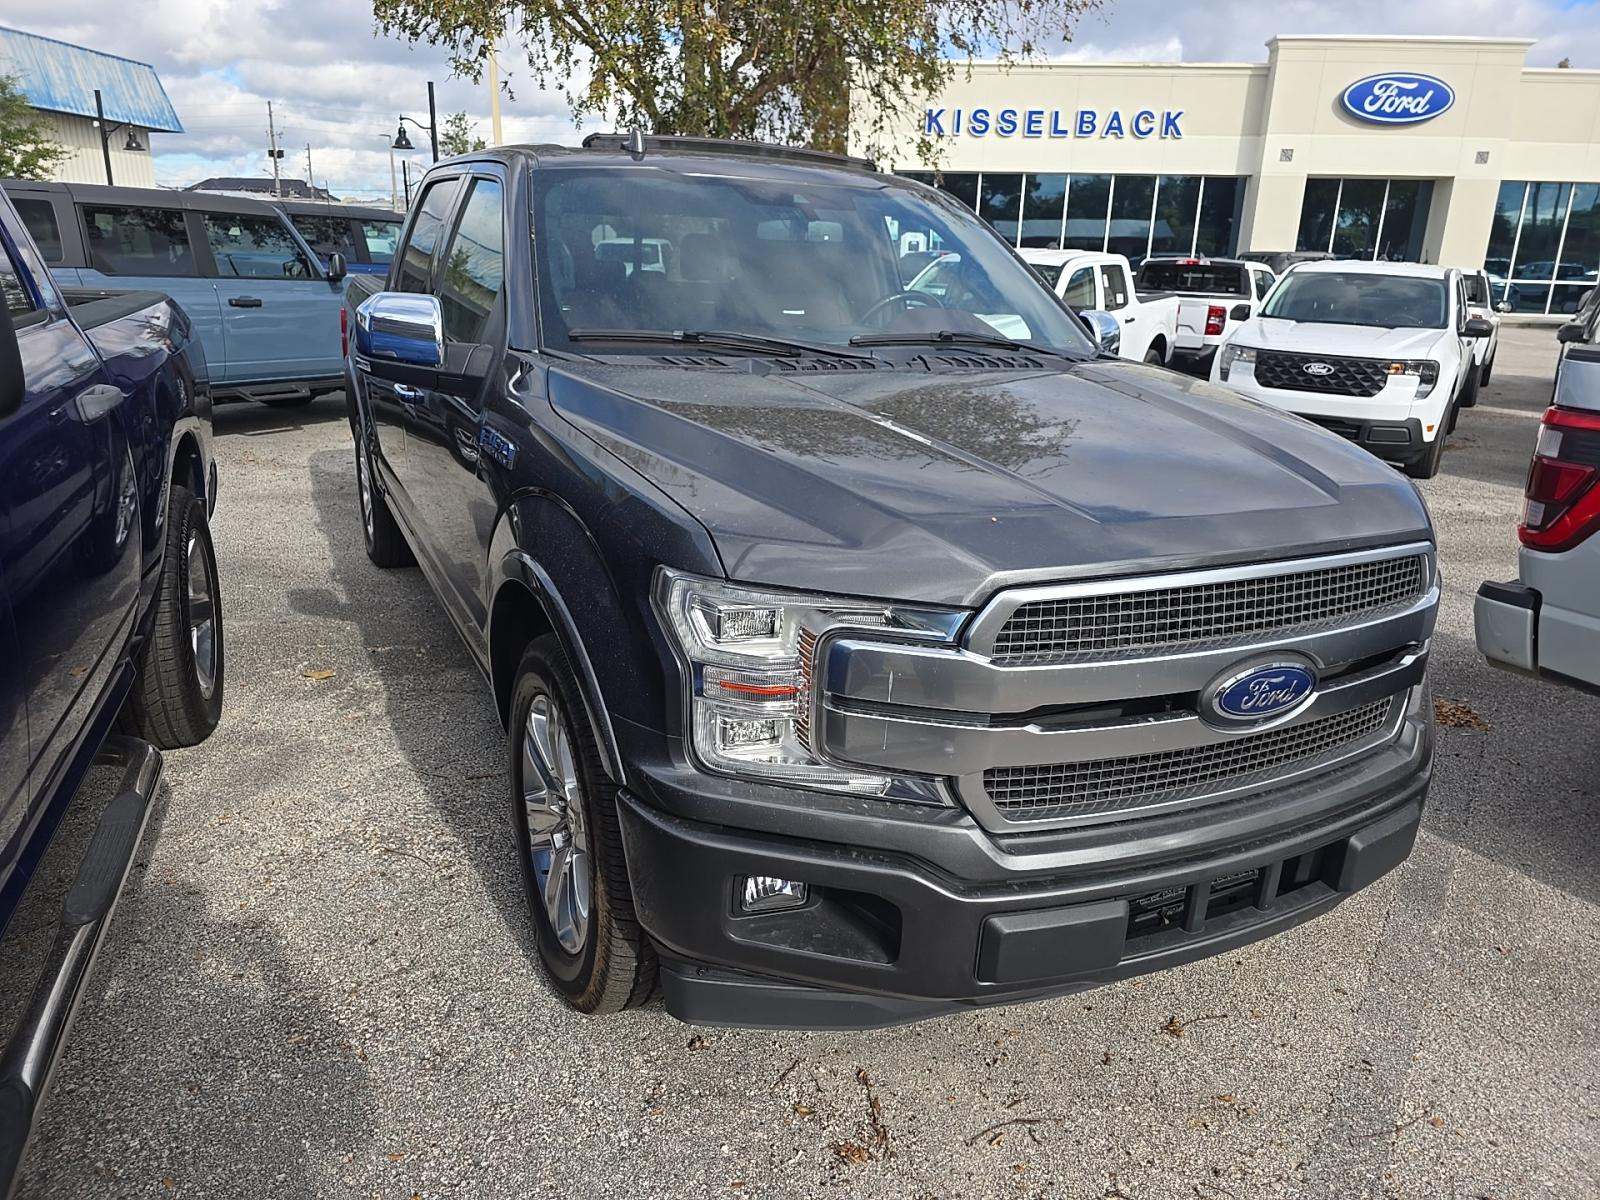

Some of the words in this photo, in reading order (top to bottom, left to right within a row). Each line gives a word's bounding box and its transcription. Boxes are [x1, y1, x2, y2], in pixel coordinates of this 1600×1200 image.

[1363, 79, 1435, 114] Ford
[925, 107, 1185, 140] KISSELBACK
[1240, 675, 1298, 710] Ford
